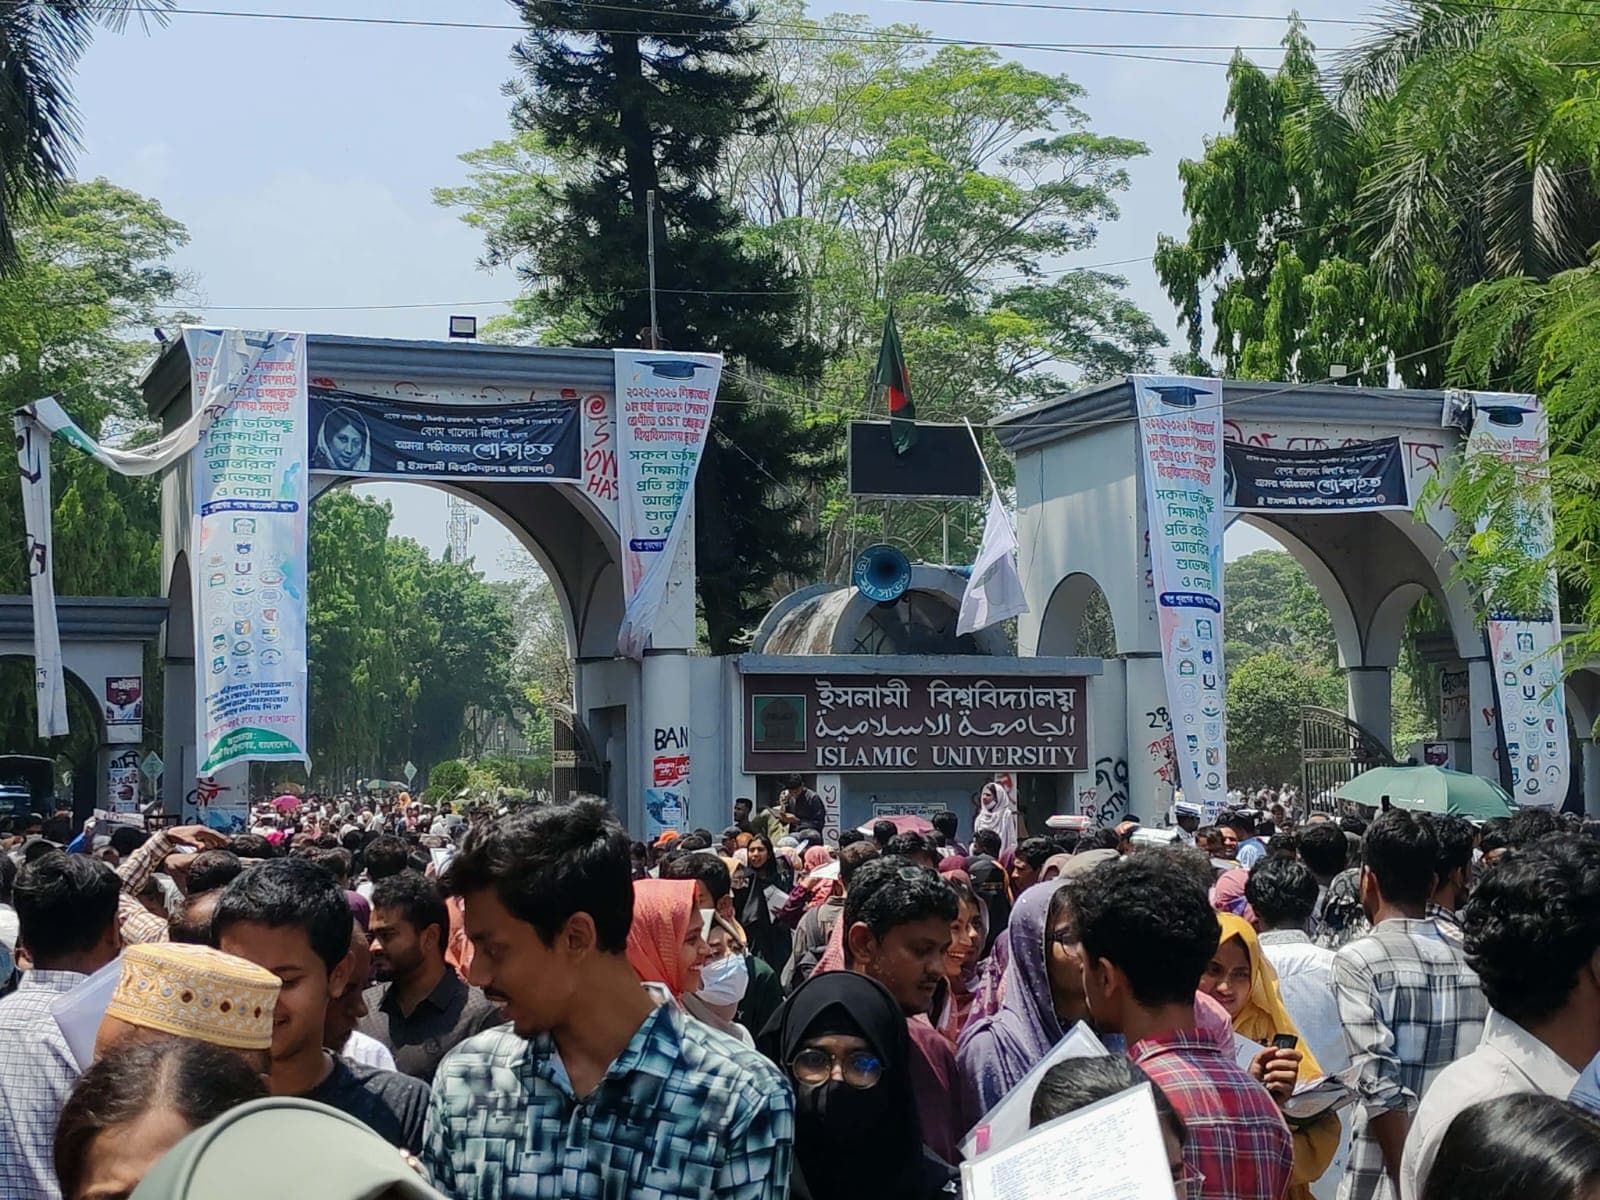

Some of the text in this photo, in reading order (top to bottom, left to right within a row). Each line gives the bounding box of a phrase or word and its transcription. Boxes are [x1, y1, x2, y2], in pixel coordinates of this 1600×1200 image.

[658, 416, 680, 426] GST
[421, 427, 444, 437] বেগম
[448, 428, 478, 438] খালেদা
[204, 443, 283, 457] প্রতি রইলো
[395, 440, 555, 462] আমরা গভীরভাবে শোকাহত
[629, 450, 668, 460] সকল
[1174, 451, 1192, 463] GST
[208, 458, 276, 470] আন্তরিক
[408, 460, 445, 471] ইসলামী
[447, 462, 506, 473] বিশ্ববিদ্যালয়
[212, 473, 272, 483] শুভেচ্ছা
[636, 477, 662, 491] প্রতি
[1316, 475, 1382, 494] শোকাহত
[217, 487, 272, 497] ও দোয়া
[1155, 489, 1187, 500] সকল
[1165, 520, 1187, 536] প্রতি
[816, 678, 1077, 712] ইসলামী বিশ্ববিদ্যালয়
[816, 709, 1075, 742] الجامعة الاسلامية
[654, 726, 688, 751] BAN
[816, 746, 1077, 767] ISLAMIC UNIVERSITY
